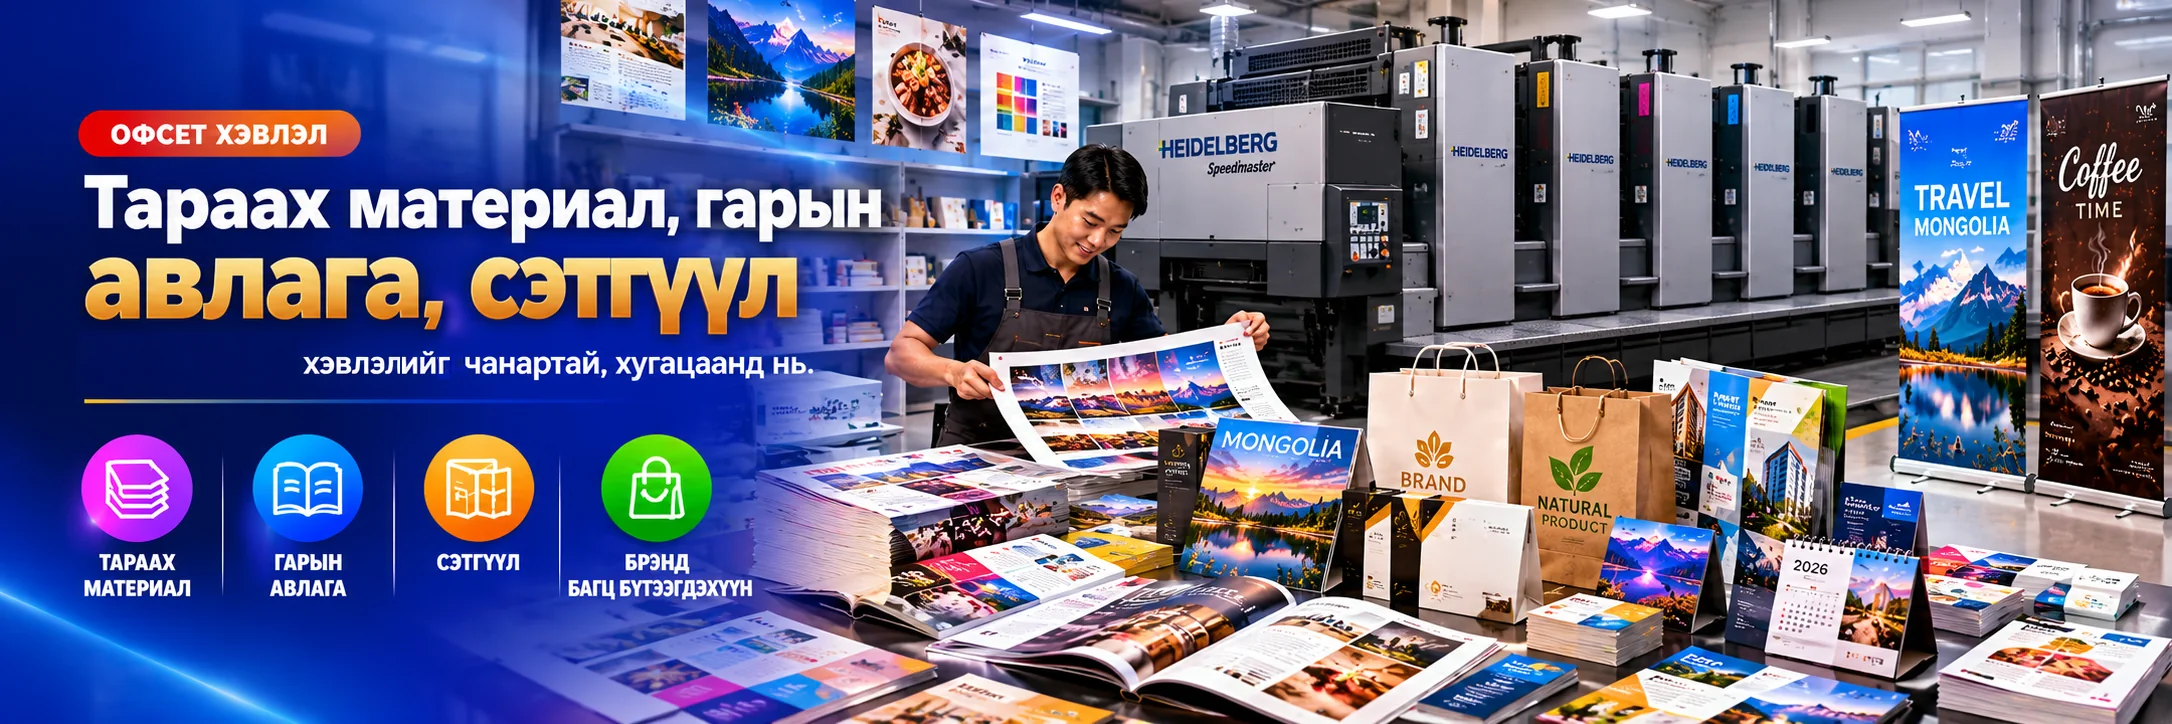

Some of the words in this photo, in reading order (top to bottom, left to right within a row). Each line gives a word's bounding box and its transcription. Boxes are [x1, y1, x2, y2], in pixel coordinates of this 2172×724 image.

[1160, 131, 1278, 159] HEIDELBERG
[1453, 145, 1508, 160] HEIDELBERG
[1567, 152, 1614, 165] HEIDELBERG
[2058, 141, 2143, 200] Coffee
[1914, 180, 2010, 211] TRAVEL
[2075, 200, 2123, 220] TIME
[1914, 215, 2011, 237] MONGOLIA
[1400, 471, 1467, 493] BRAND
[1537, 495, 1613, 519] NATURAL
[1541, 514, 1609, 535] PRODUCT
[1793, 559, 1829, 576] 2026
